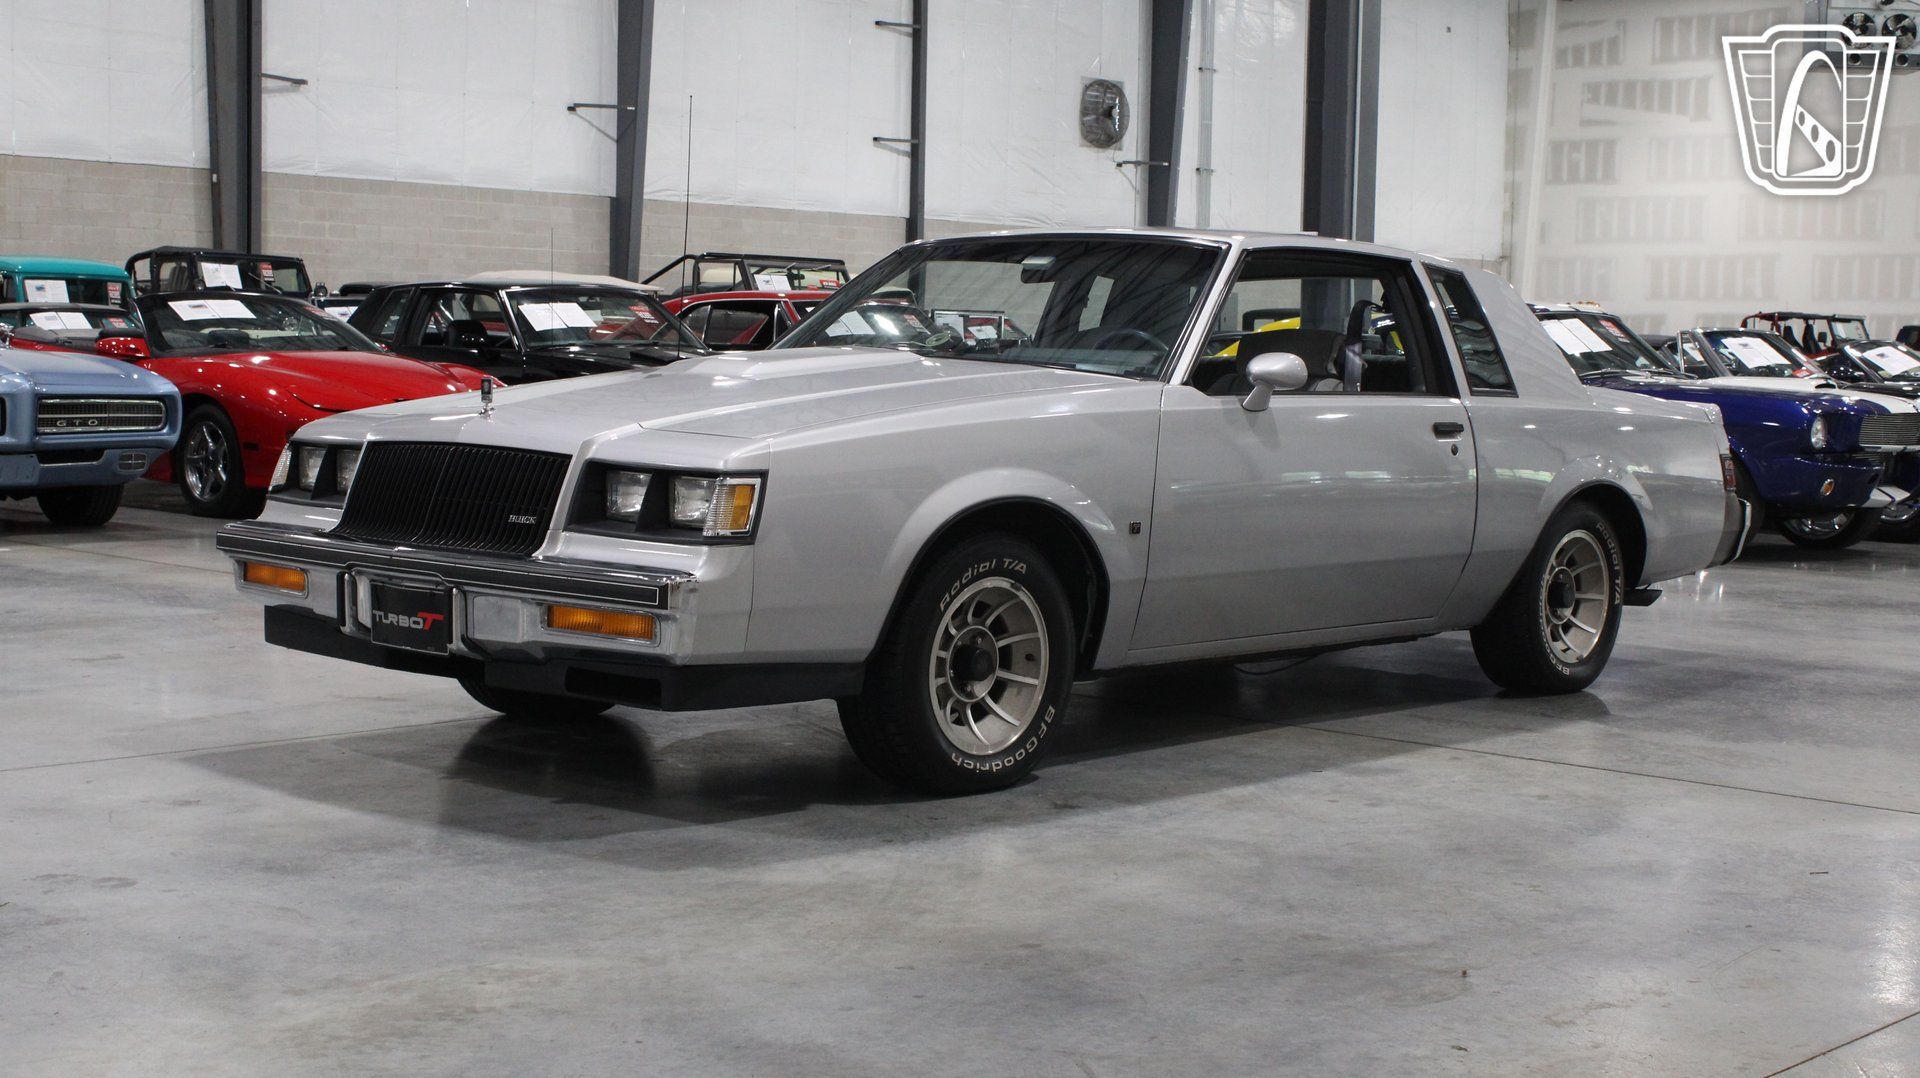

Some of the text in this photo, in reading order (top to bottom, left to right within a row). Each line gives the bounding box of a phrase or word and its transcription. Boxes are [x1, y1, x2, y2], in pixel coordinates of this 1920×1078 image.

[56, 419, 98, 427] GTO
[508, 514, 537, 524] BUICK
[940, 558, 1027, 612] Radial T/A
[951, 705, 1055, 772] BFGoodrich
